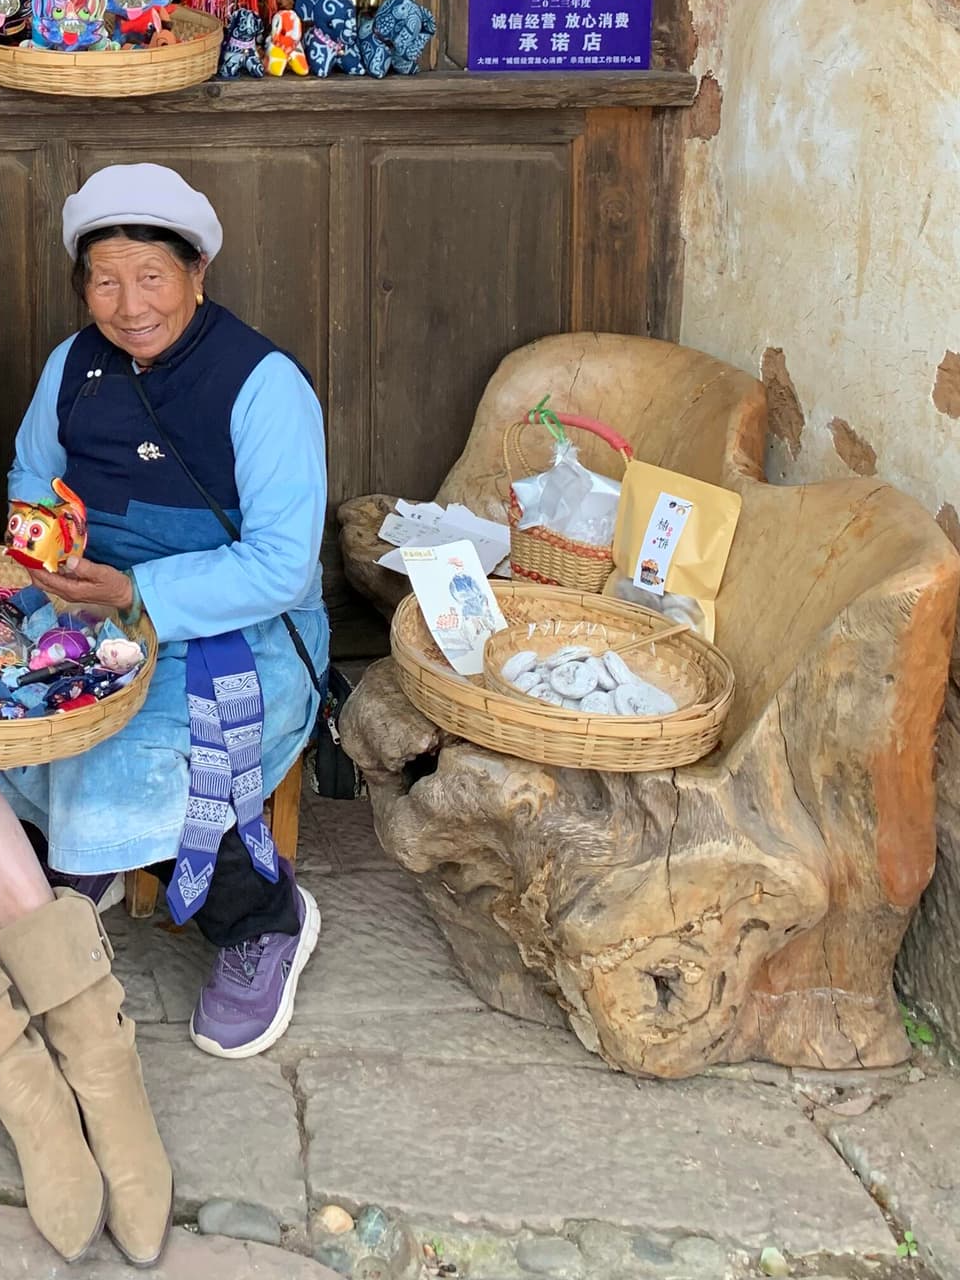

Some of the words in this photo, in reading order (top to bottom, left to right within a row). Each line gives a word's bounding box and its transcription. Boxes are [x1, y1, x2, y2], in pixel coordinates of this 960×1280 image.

[491, 13, 556, 30] 诚信经营
[565, 12, 630, 29] 放心消费
[518, 32, 602, 52] 承诺店
